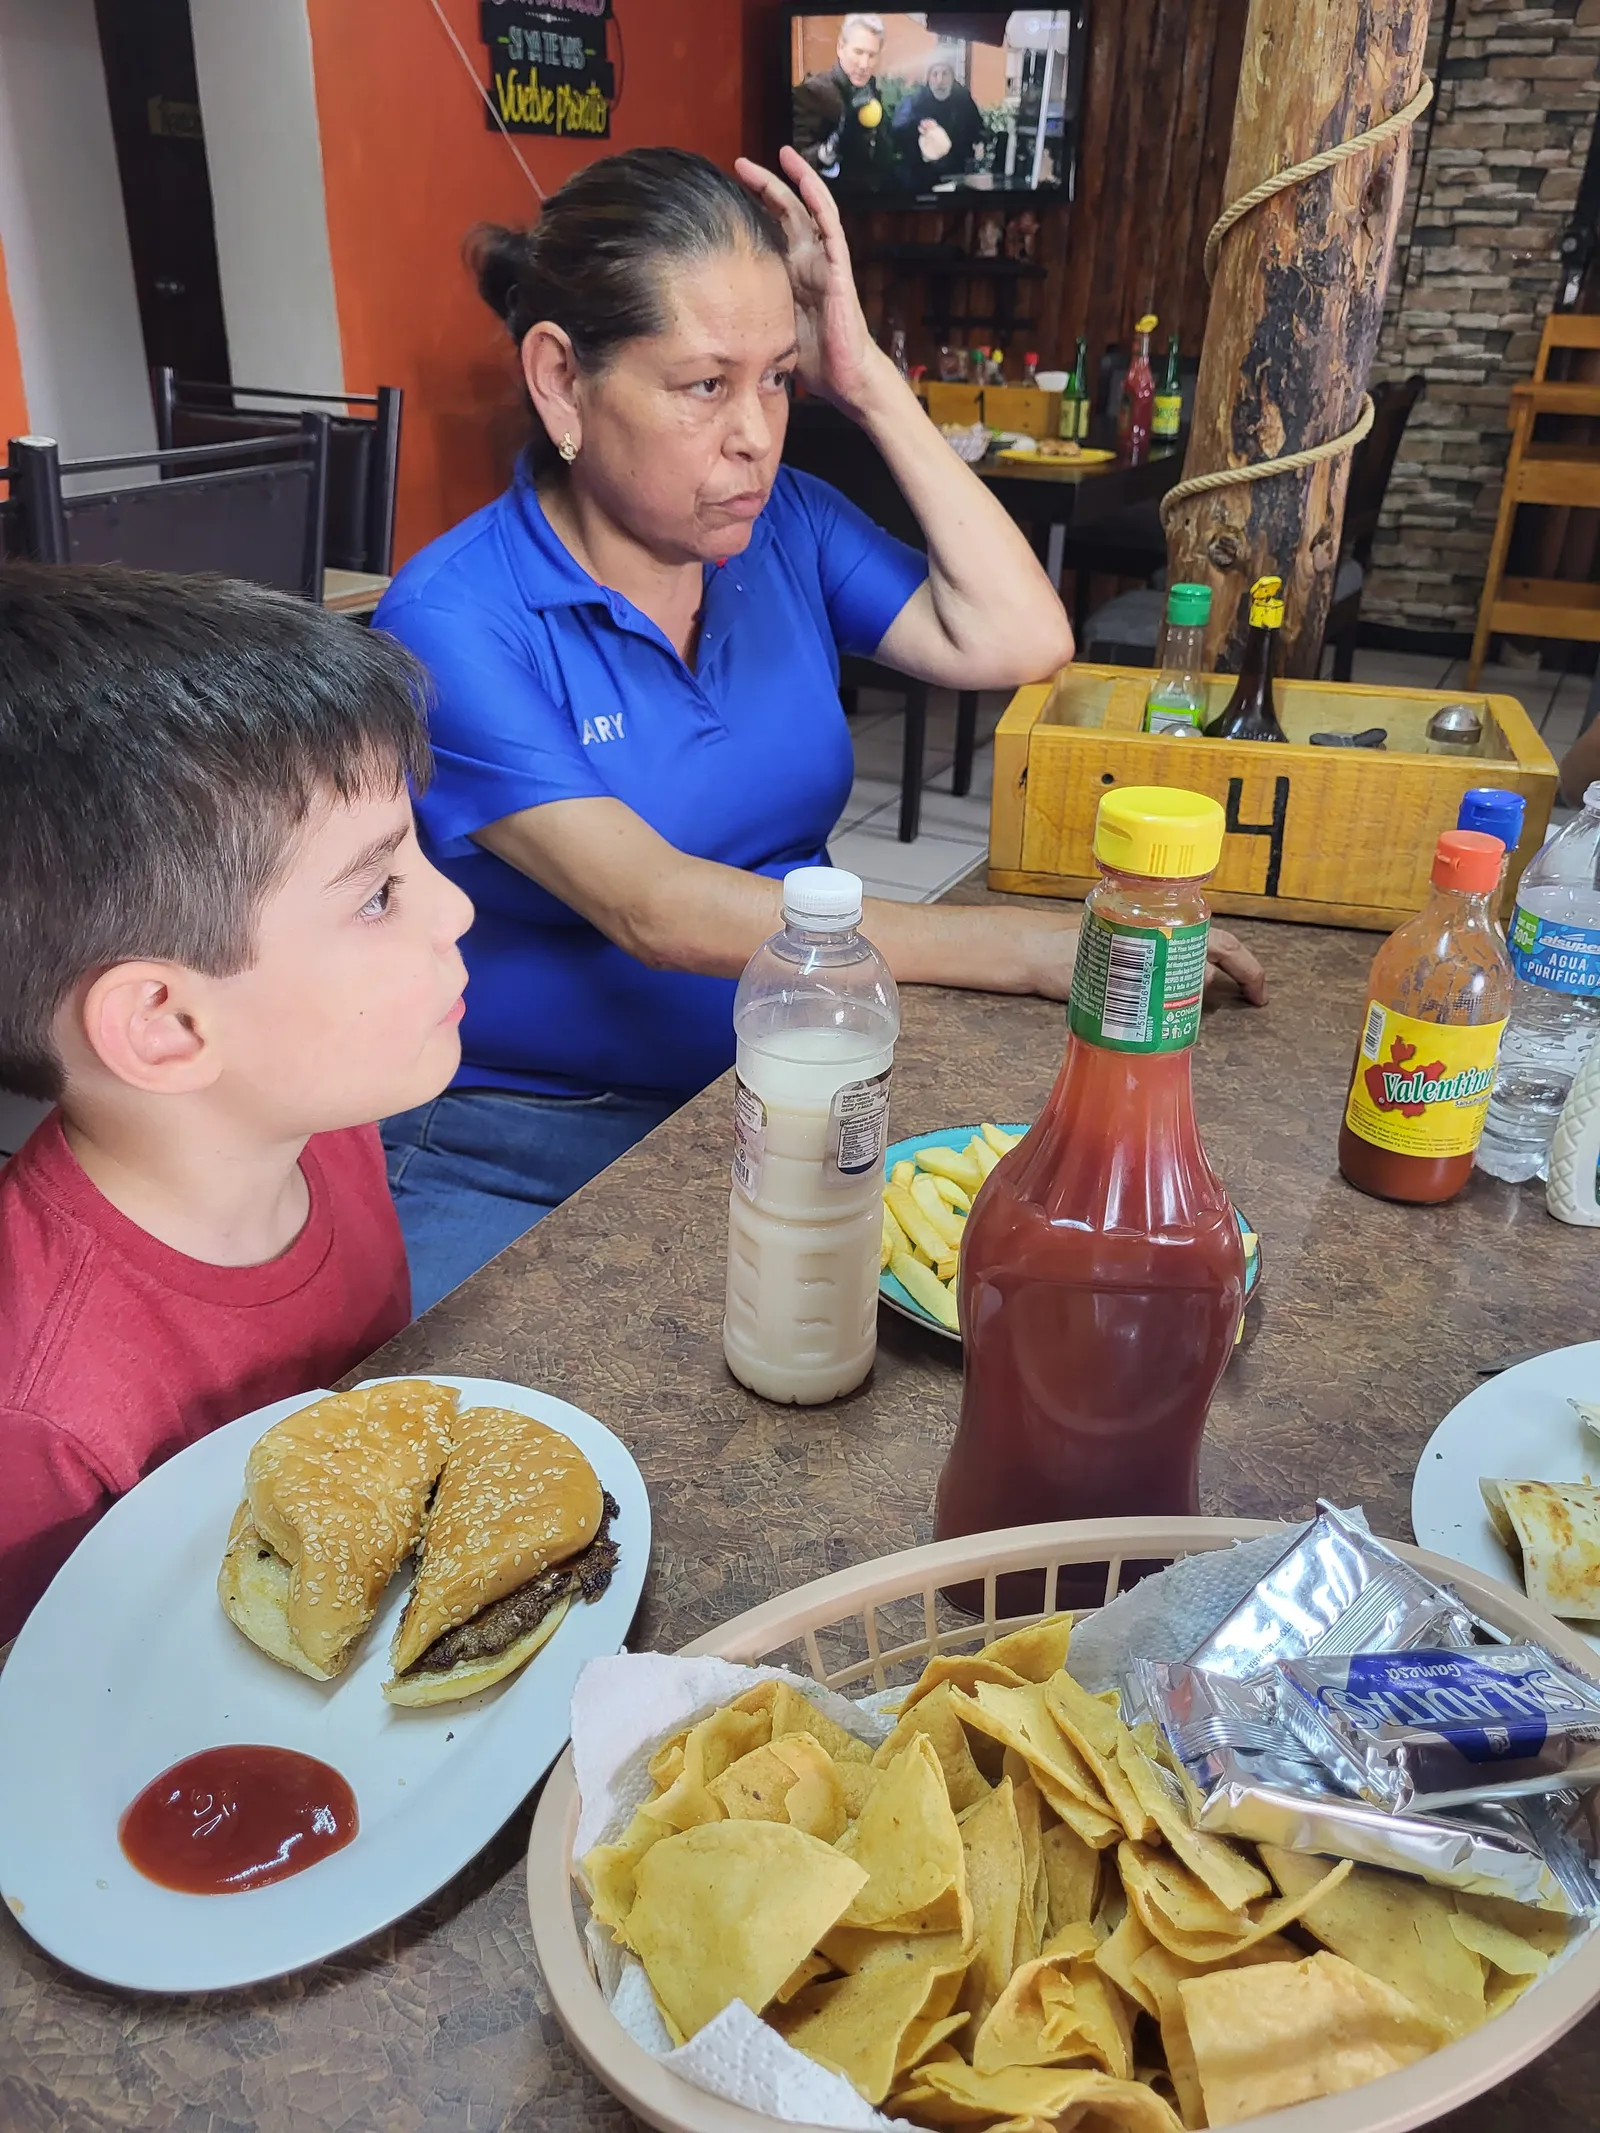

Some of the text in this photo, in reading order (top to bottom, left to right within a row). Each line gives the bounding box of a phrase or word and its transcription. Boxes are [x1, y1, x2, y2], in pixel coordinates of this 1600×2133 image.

[582, 712, 625, 746] ARY
[1228, 776, 1290, 896] 4
[1541, 935, 1600, 953] alsupe
[1549, 953, 1587, 971] AGUA
[1384, 1661, 1461, 1680] Gamesa
[1317, 1669, 1586, 1730] SALADITAS
